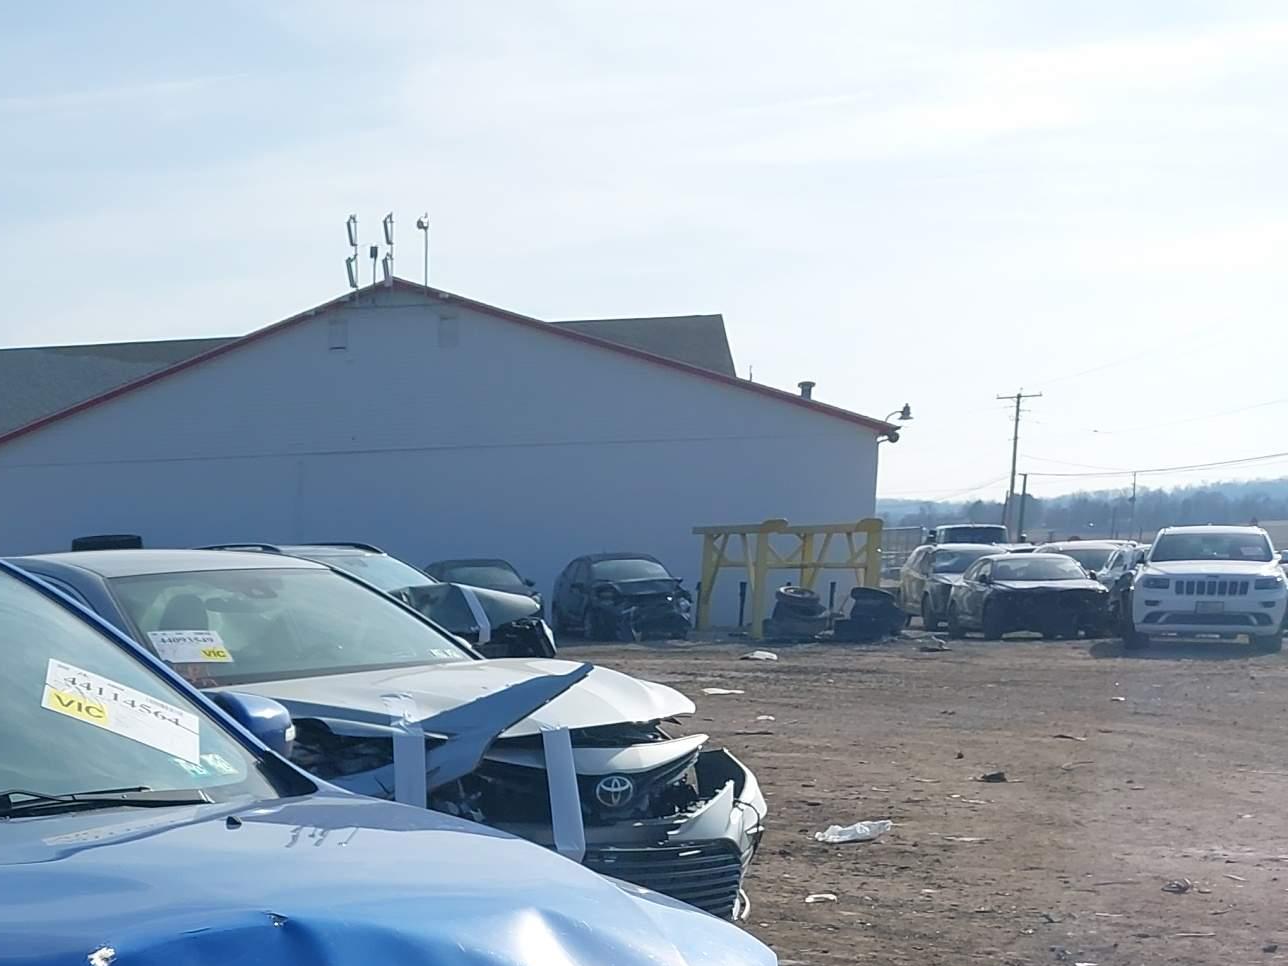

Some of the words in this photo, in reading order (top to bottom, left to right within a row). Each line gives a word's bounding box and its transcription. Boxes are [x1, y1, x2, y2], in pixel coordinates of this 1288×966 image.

[201, 649, 227, 658] VIC
[54, 692, 105, 719] VIC
[63, 676, 181, 727] 44114564
